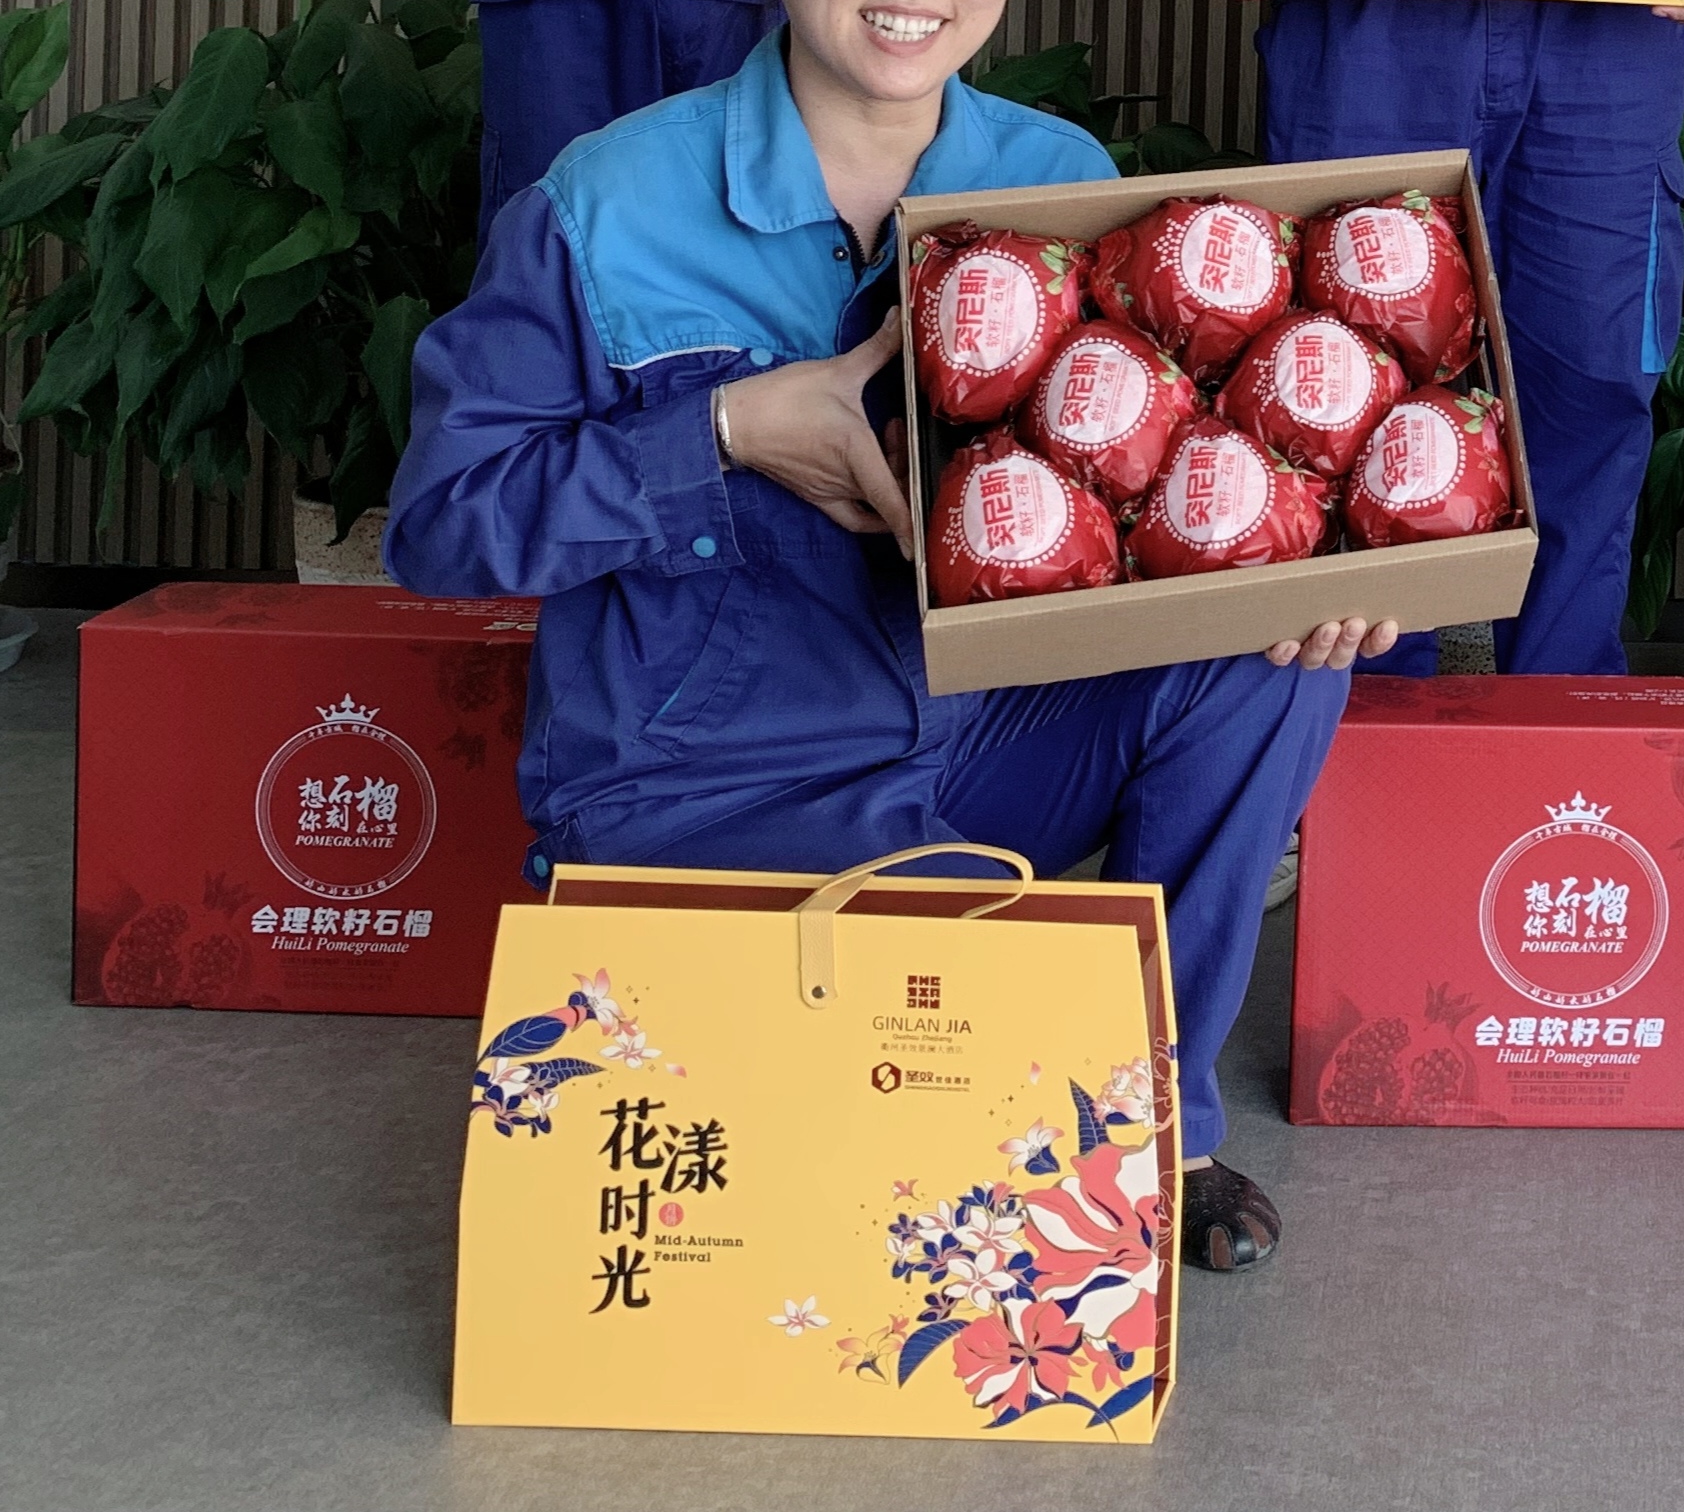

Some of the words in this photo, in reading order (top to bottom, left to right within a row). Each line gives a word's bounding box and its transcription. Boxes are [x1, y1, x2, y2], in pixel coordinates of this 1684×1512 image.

[356, 821, 398, 836] 在心里
[295, 835, 394, 849] POMEGRANATE
[251, 904, 433, 938] 会理软籽石榴
[1584, 925, 1628, 940] 在心里
[271, 936, 312, 951] HuiLi
[316, 938, 410, 956] Pomegranate
[1520, 941, 1624, 954] POMEGRANATE
[872, 1016, 940, 1032] GINLAN
[946, 1019, 972, 1034] JIA
[1474, 1015, 1665, 1048] 会理软籽石榴
[1496, 1049, 1540, 1064] HuiLi
[1543, 1049, 1641, 1068] Pomegranate
[654, 1235, 744, 1247] Mid-Autumn
[654, 1251, 711, 1263] Festival
